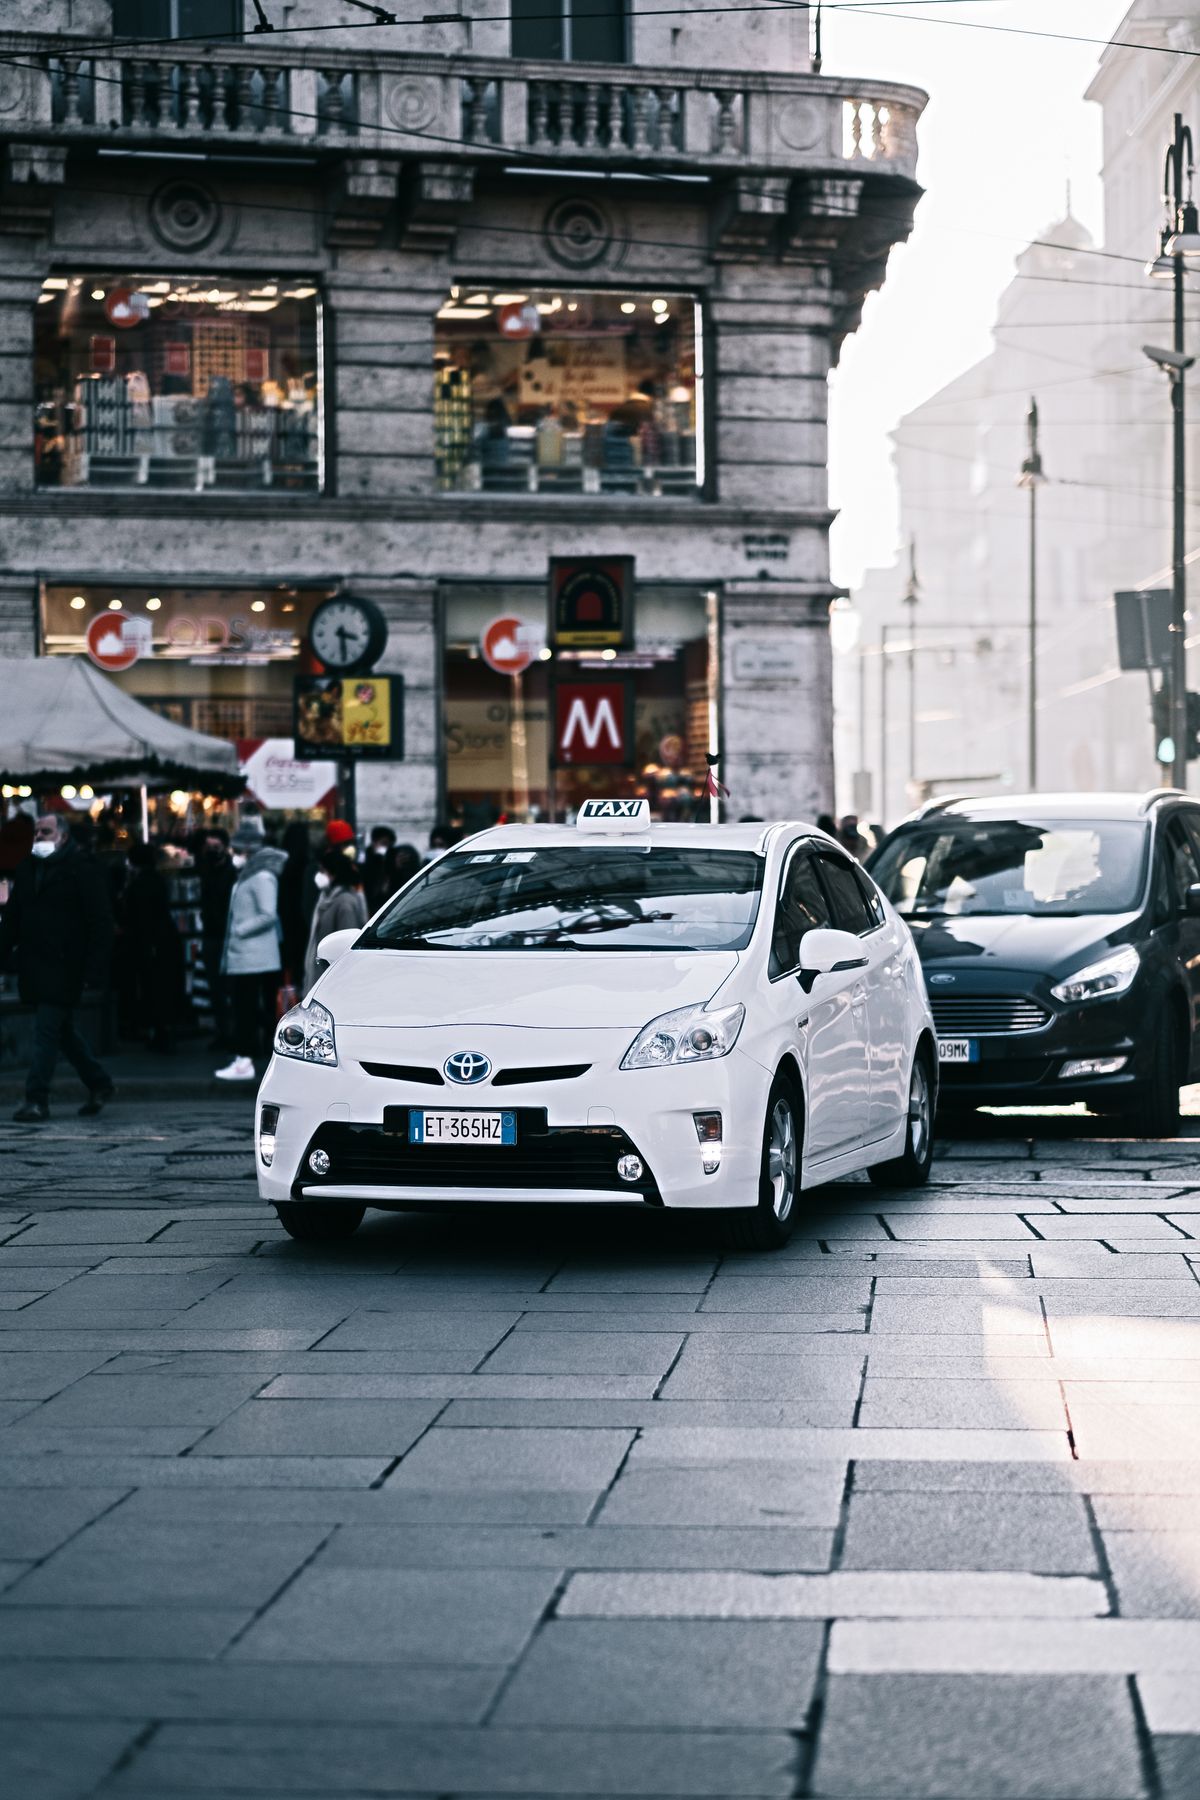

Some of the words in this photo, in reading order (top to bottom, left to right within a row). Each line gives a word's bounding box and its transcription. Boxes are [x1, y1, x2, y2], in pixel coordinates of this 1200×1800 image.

[561, 698, 621, 749] M
[588, 801, 641, 816] TAXI
[939, 1043, 968, 1058] 09MK
